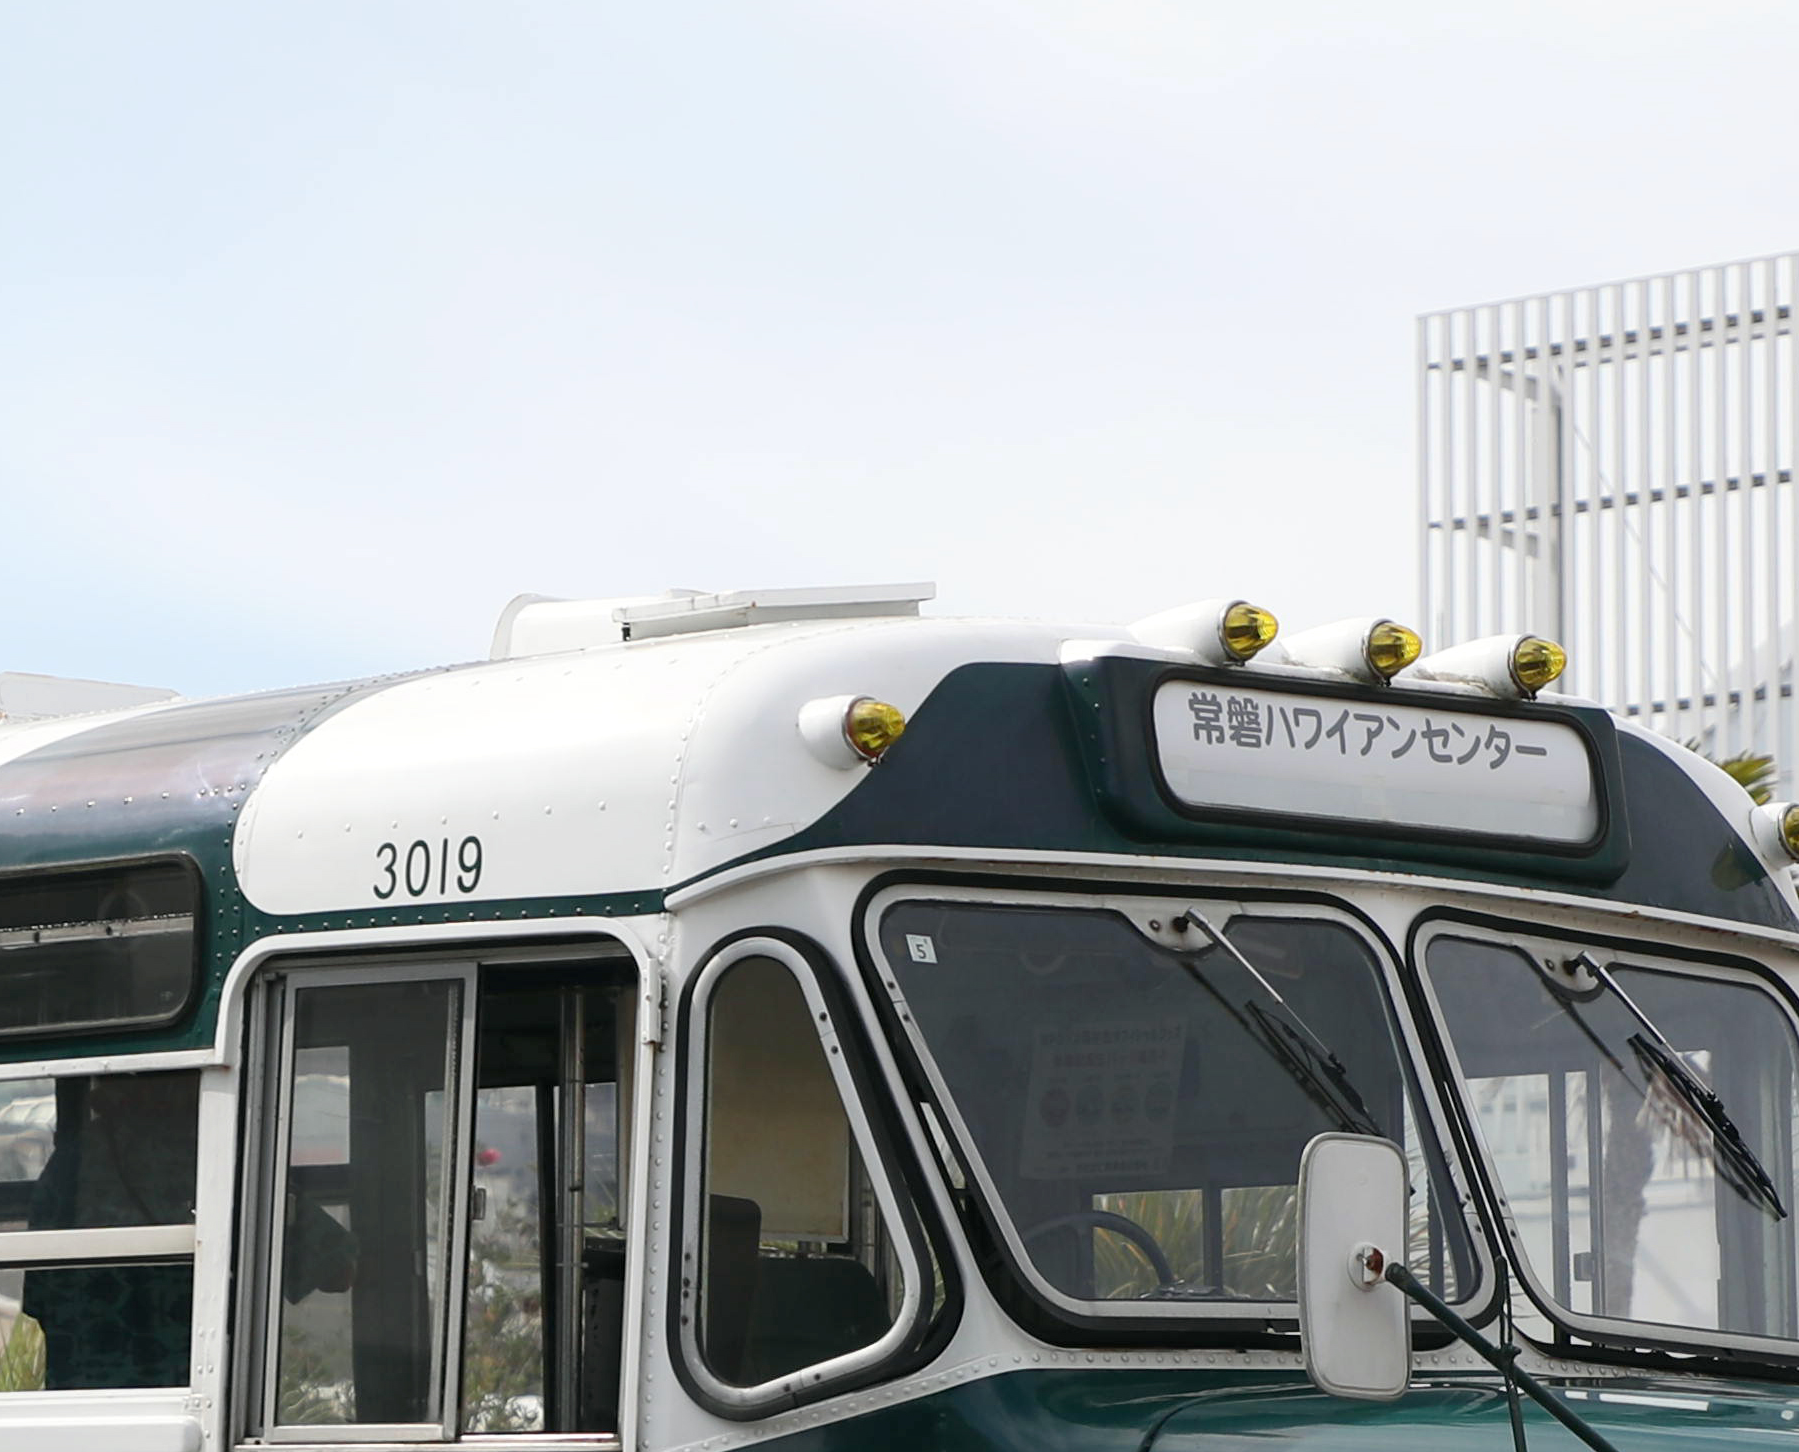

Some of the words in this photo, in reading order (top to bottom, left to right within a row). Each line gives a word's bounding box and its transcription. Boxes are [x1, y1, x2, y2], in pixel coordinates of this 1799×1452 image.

[1187, 691, 1547, 769] 常磐ハワイアンセンター
[373, 835, 482, 899] 3019
